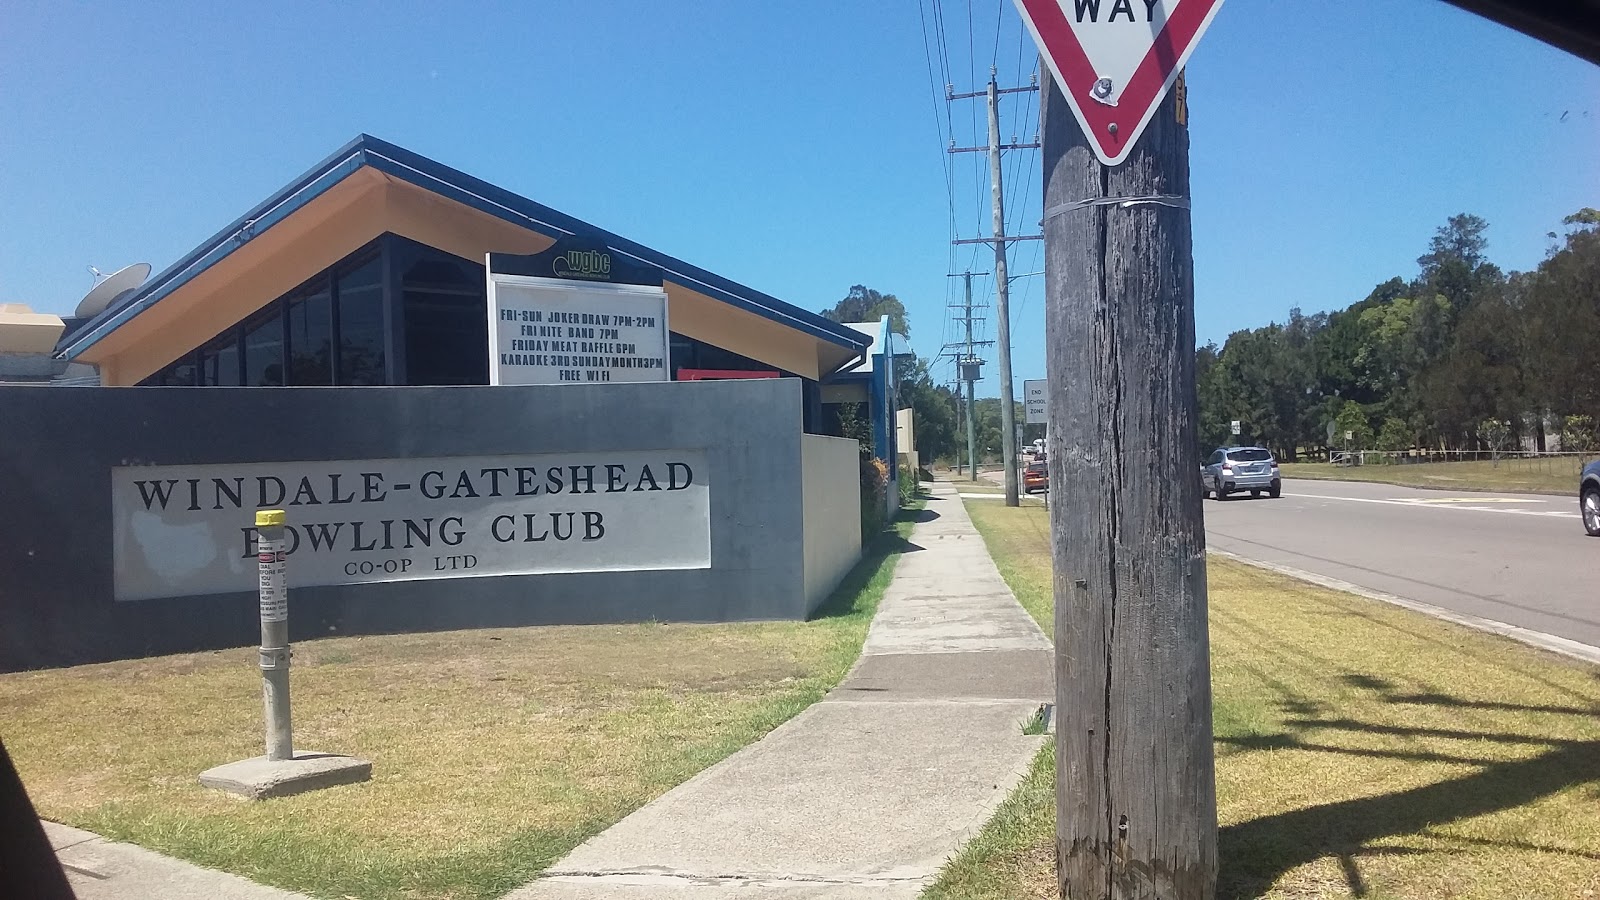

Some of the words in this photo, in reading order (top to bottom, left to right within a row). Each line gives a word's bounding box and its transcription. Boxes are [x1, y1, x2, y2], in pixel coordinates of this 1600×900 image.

[1074, 0, 1158, 23] WAY
[567, 250, 611, 273] wgbc
[501, 309, 542, 322] FRI-SUN
[548, 311, 579, 324] JOKER
[582, 313, 610, 326] DRAW
[613, 315, 655, 328] 7PM-2PM
[521, 325, 537, 336] FRI
[540, 326, 562, 338] NITE
[568, 327, 594, 339] BAND
[599, 328, 619, 340] 7PM
[512, 340, 548, 352] FRIDAY
[551, 341, 578, 352] MEAT
[616, 343, 636, 354] 6PM
[501, 353, 548, 366] KARAOKE
[550, 355, 570, 367] 3RD
[559, 369, 581, 381] FREE
[491, 511, 606, 543] CLUB
[344, 558, 412, 576] CO-OP
[434, 554, 478, 571] LTD
